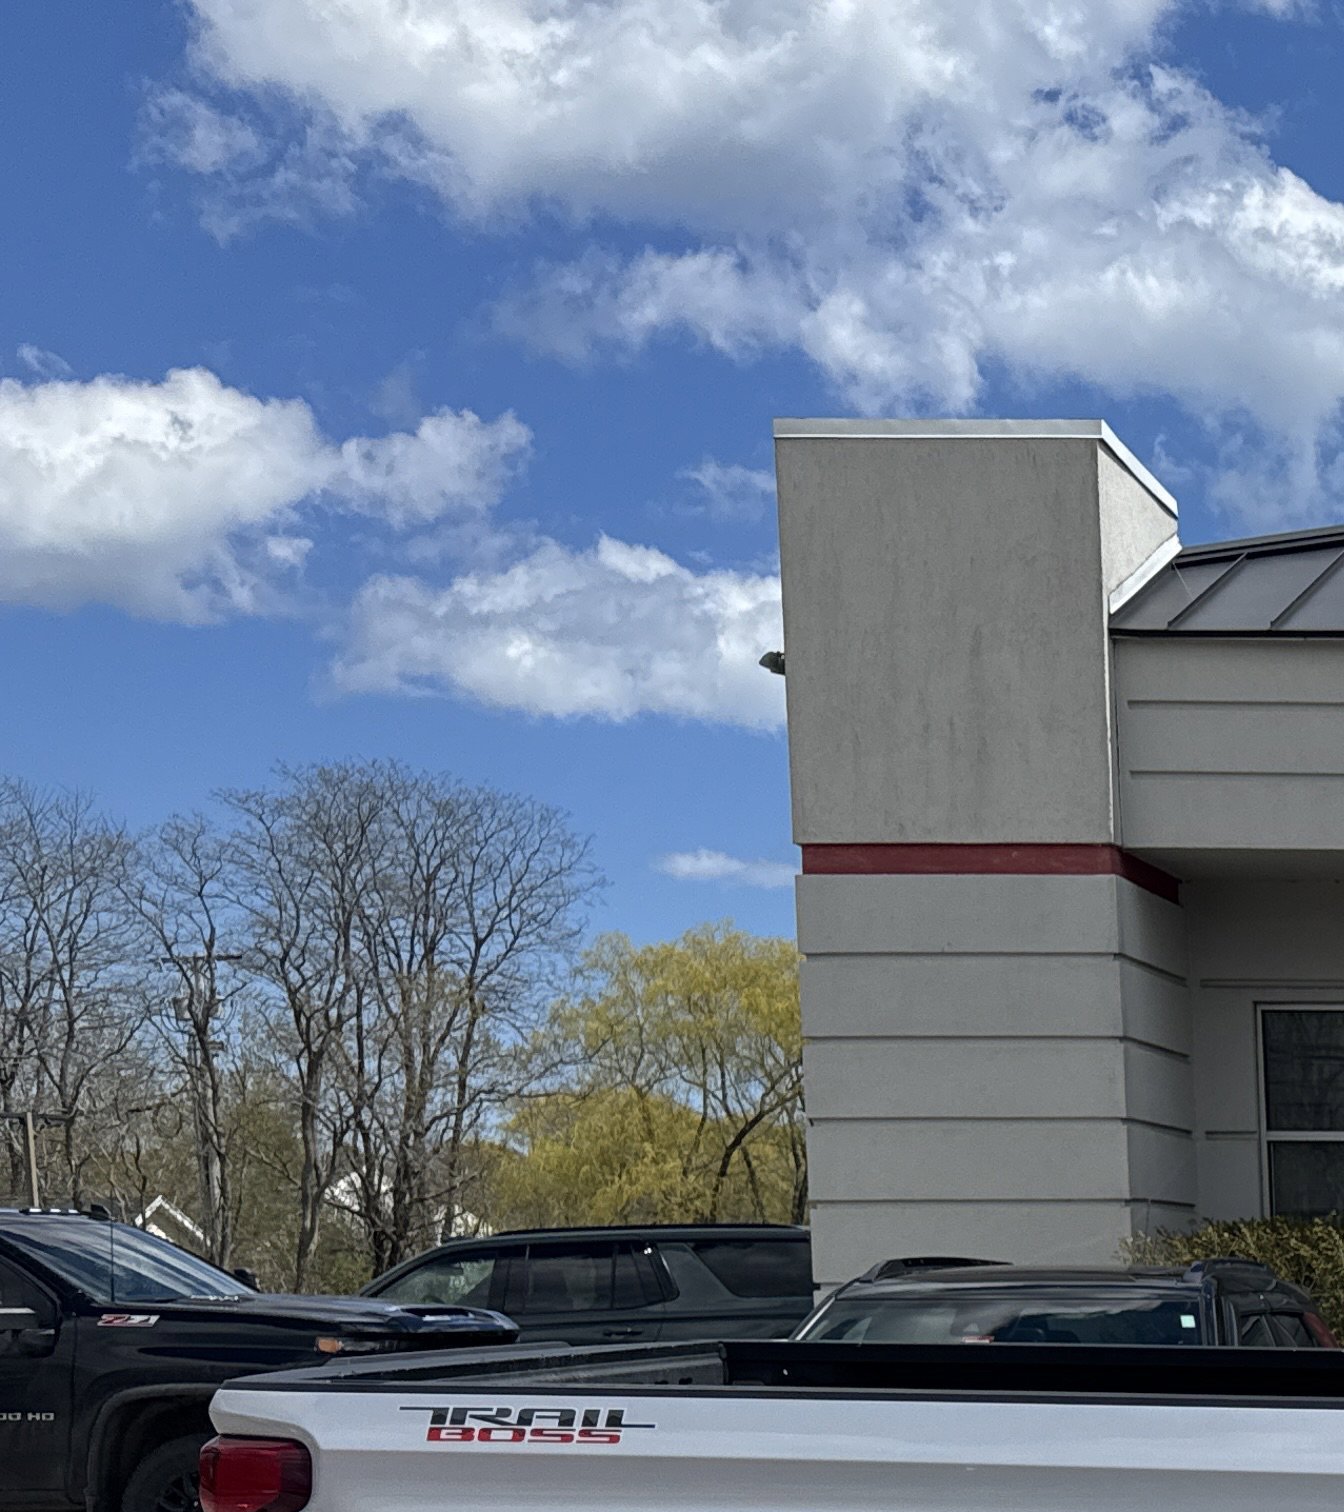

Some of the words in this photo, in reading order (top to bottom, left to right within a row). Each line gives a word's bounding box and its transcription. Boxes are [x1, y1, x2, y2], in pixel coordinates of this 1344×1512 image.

[97, 1313, 160, 1328] Z71
[27, 1412, 55, 1421] HD
[399, 1406, 656, 1429] TRAIL
[426, 1426, 622, 1444] BOSS
